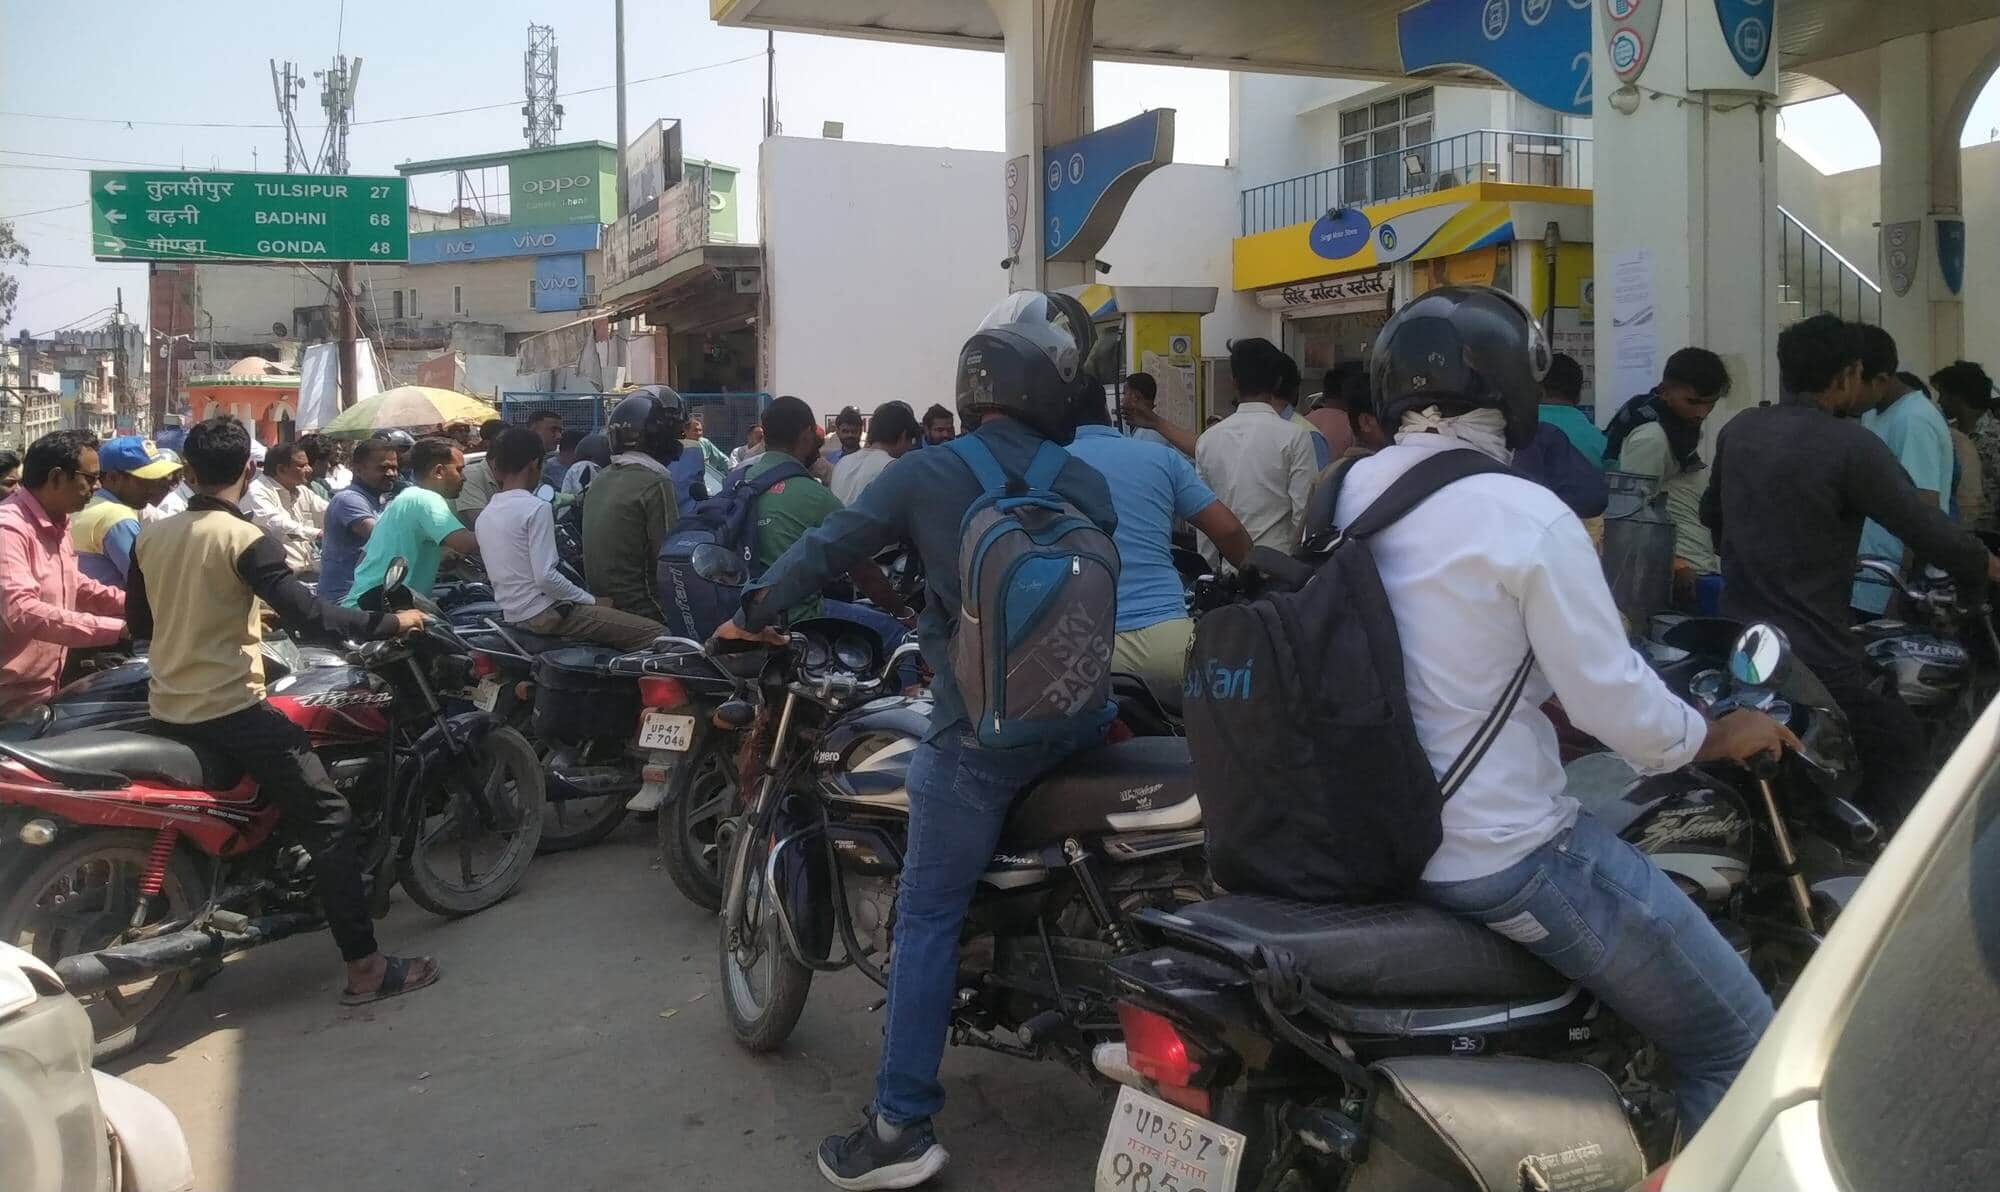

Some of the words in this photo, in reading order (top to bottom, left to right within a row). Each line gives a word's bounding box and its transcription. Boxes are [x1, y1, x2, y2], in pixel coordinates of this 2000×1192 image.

[145, 176, 235, 202] तुलसीपुर
[255, 183, 348, 198] TULSIPUR
[370, 186, 390, 199] 27
[255, 211, 326, 225] BADHNI
[369, 214, 391, 226] 68
[512, 232, 556, 248] vivo
[1051, 217, 1061, 247] 3
[257, 240, 326, 254] GONDA
[369, 241, 391, 254] 48
[539, 274, 578, 290] vivo
[1040, 599, 1096, 662] SKY
[1047, 635, 1111, 712] BAGS
[1113, 1153, 1207, 1192] 985
